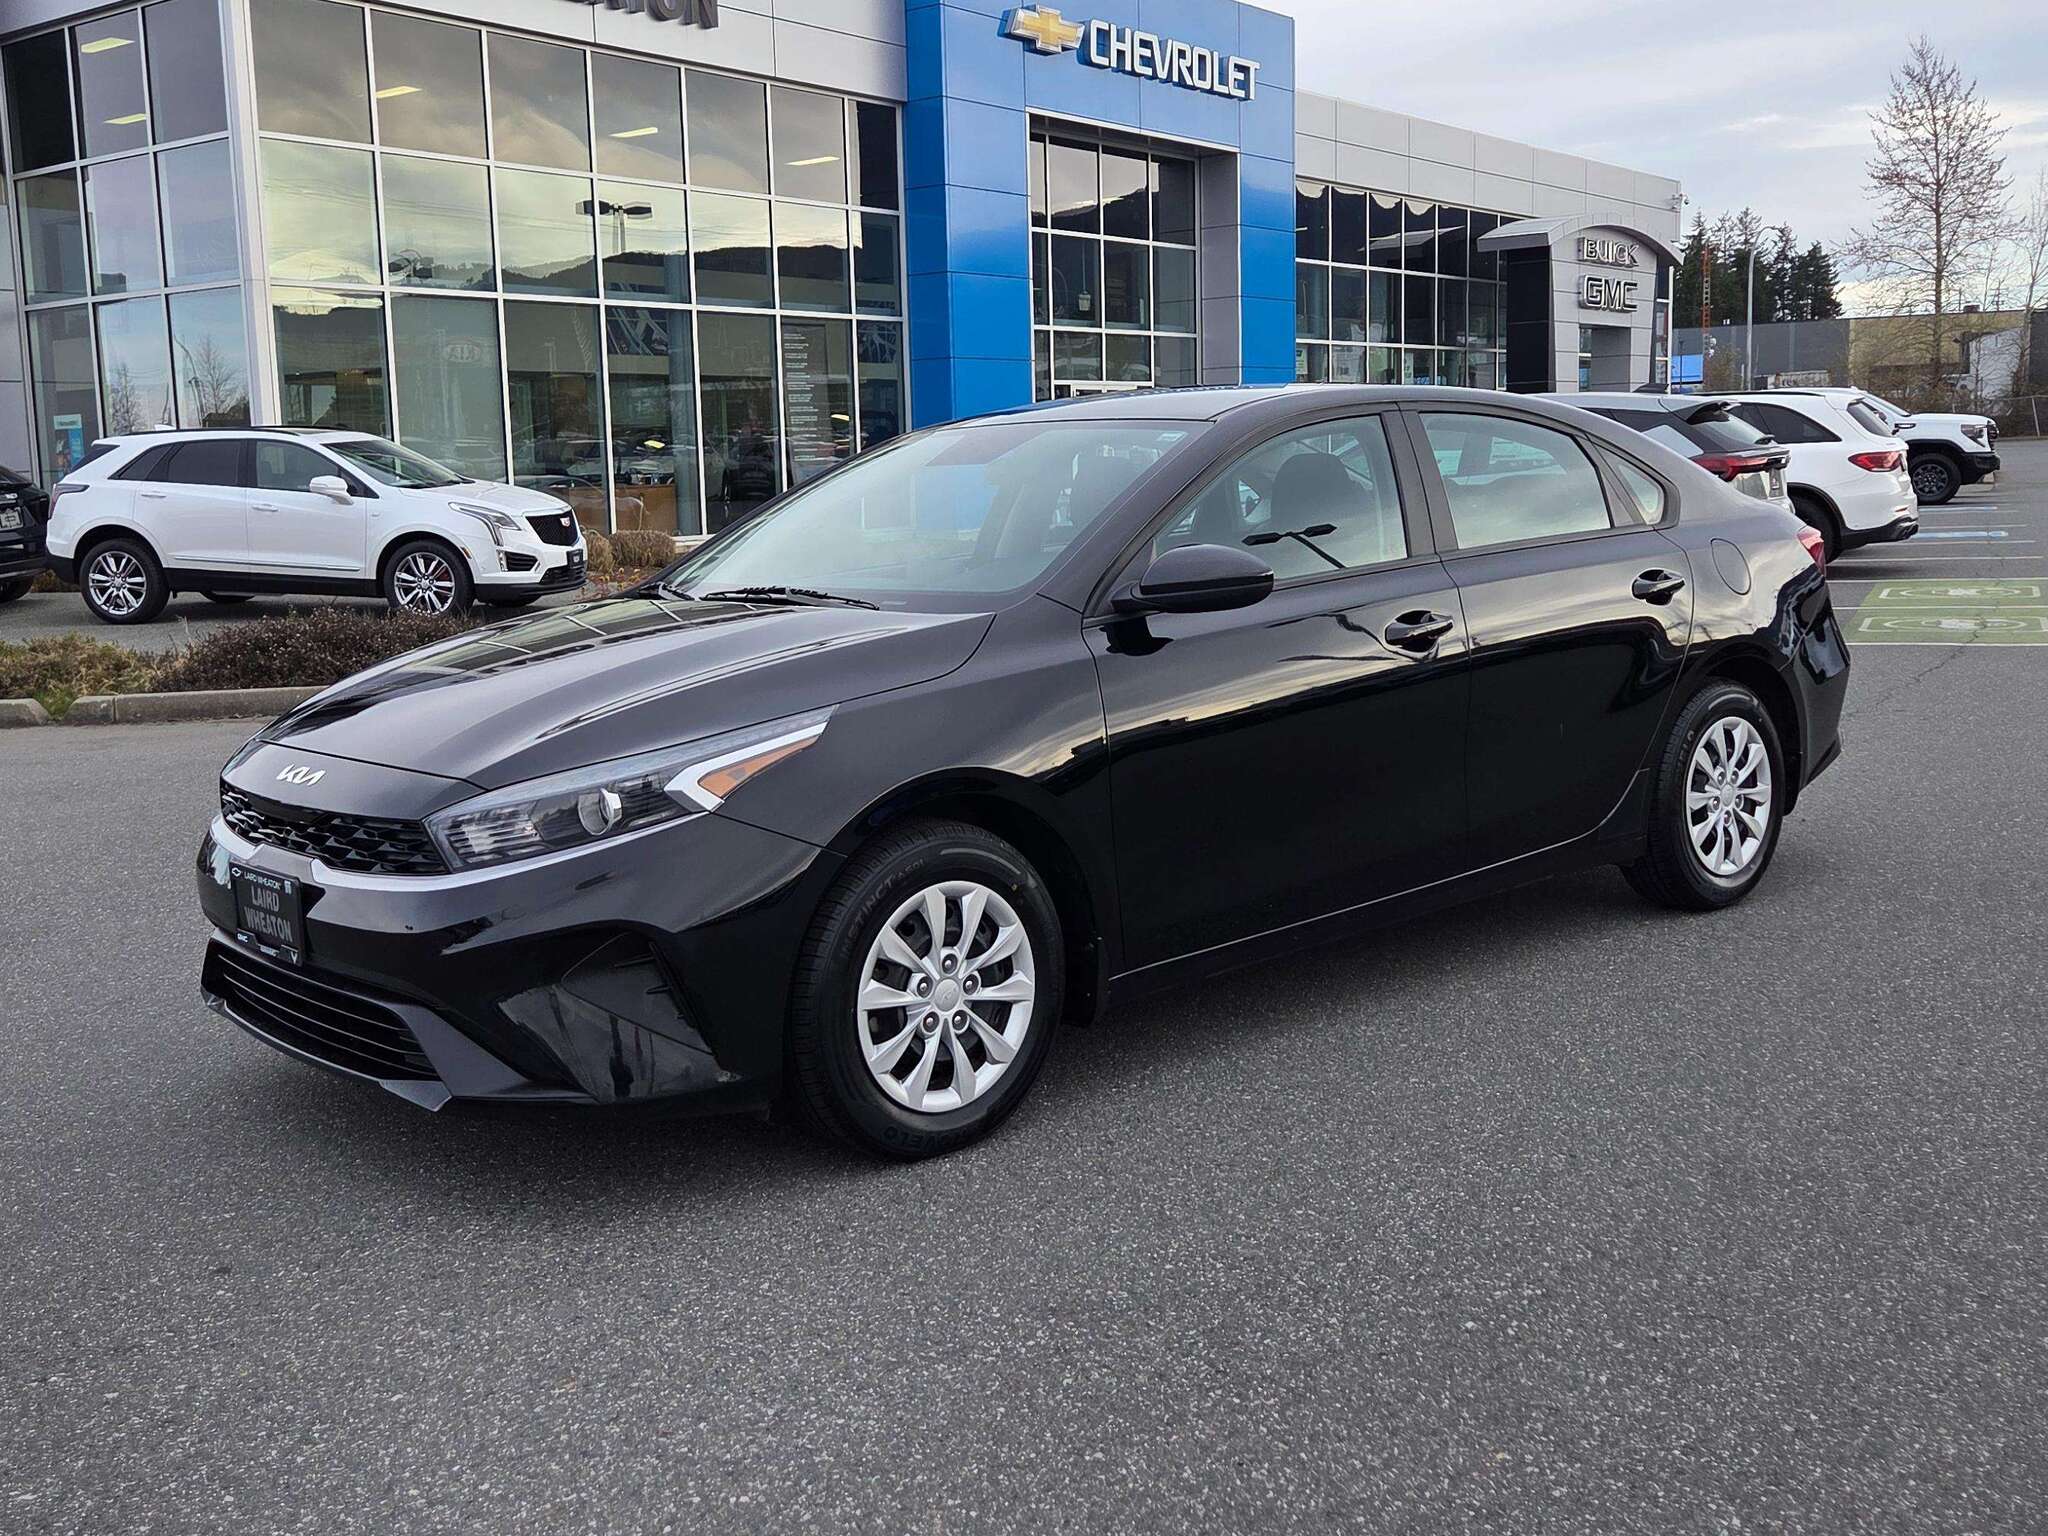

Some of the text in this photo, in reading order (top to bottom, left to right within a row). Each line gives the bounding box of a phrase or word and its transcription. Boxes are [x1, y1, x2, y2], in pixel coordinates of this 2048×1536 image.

[1090, 19, 1260, 101] CHEVROLET
[1580, 238, 1639, 266] BUICK
[1581, 274, 1638, 312] GMC
[250, 885, 280, 912] LAIRD
[243, 906, 293, 943] WHEATON
